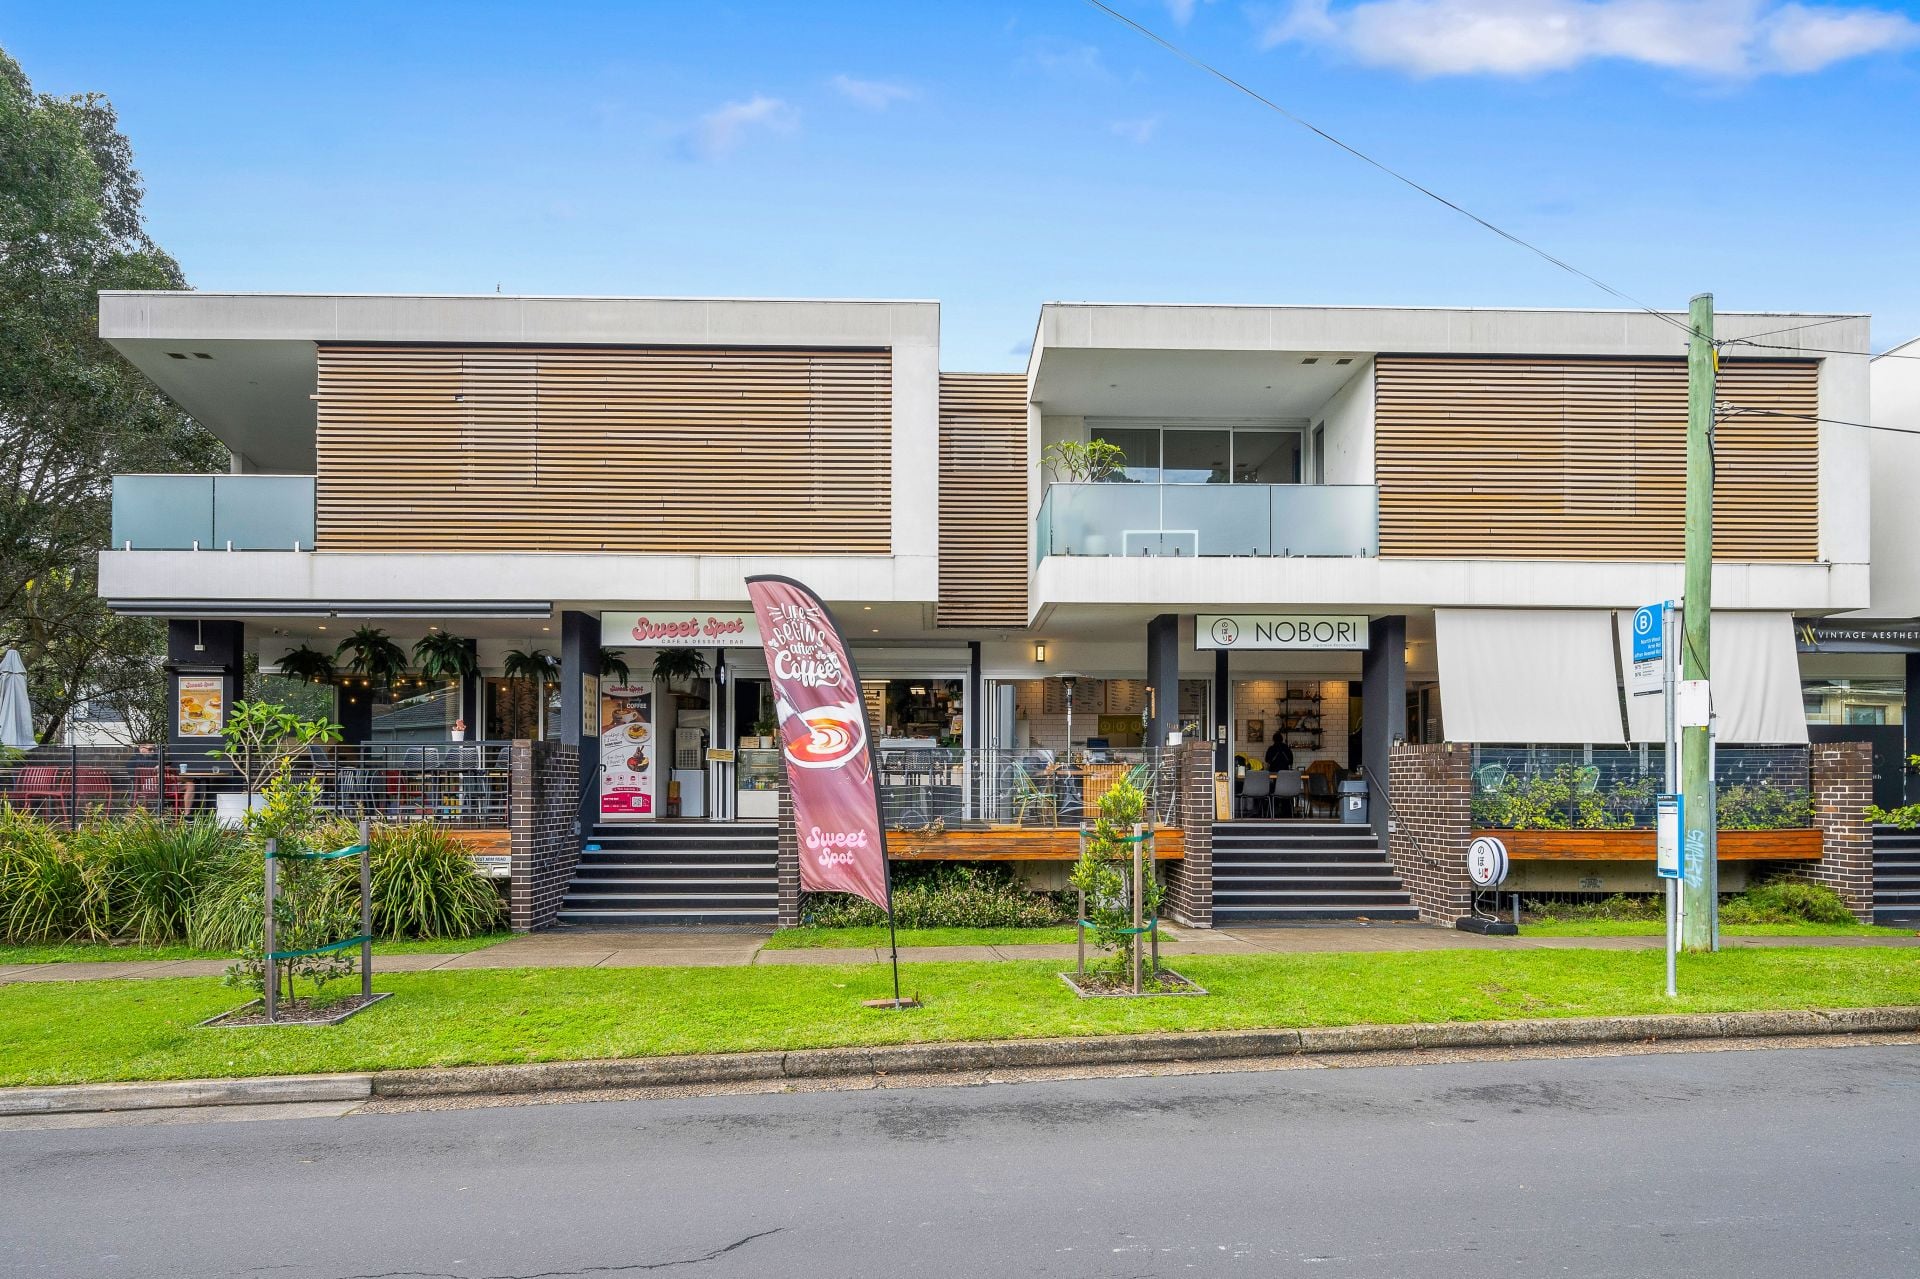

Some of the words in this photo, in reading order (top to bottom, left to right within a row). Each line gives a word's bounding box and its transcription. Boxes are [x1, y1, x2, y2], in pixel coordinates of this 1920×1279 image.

[632, 616, 700, 641] Sweet
[703, 616, 744, 639] Spot
[1255, 621, 1357, 643] NOBORI
[1640, 615, 1648, 630] B
[1818, 631, 1866, 639] VINTAGE
[1871, 631, 1919, 639] AESTHET
[774, 649, 841, 688] Coffee
[806, 826, 868, 849] Sweet
[818, 847, 854, 868] Spot
